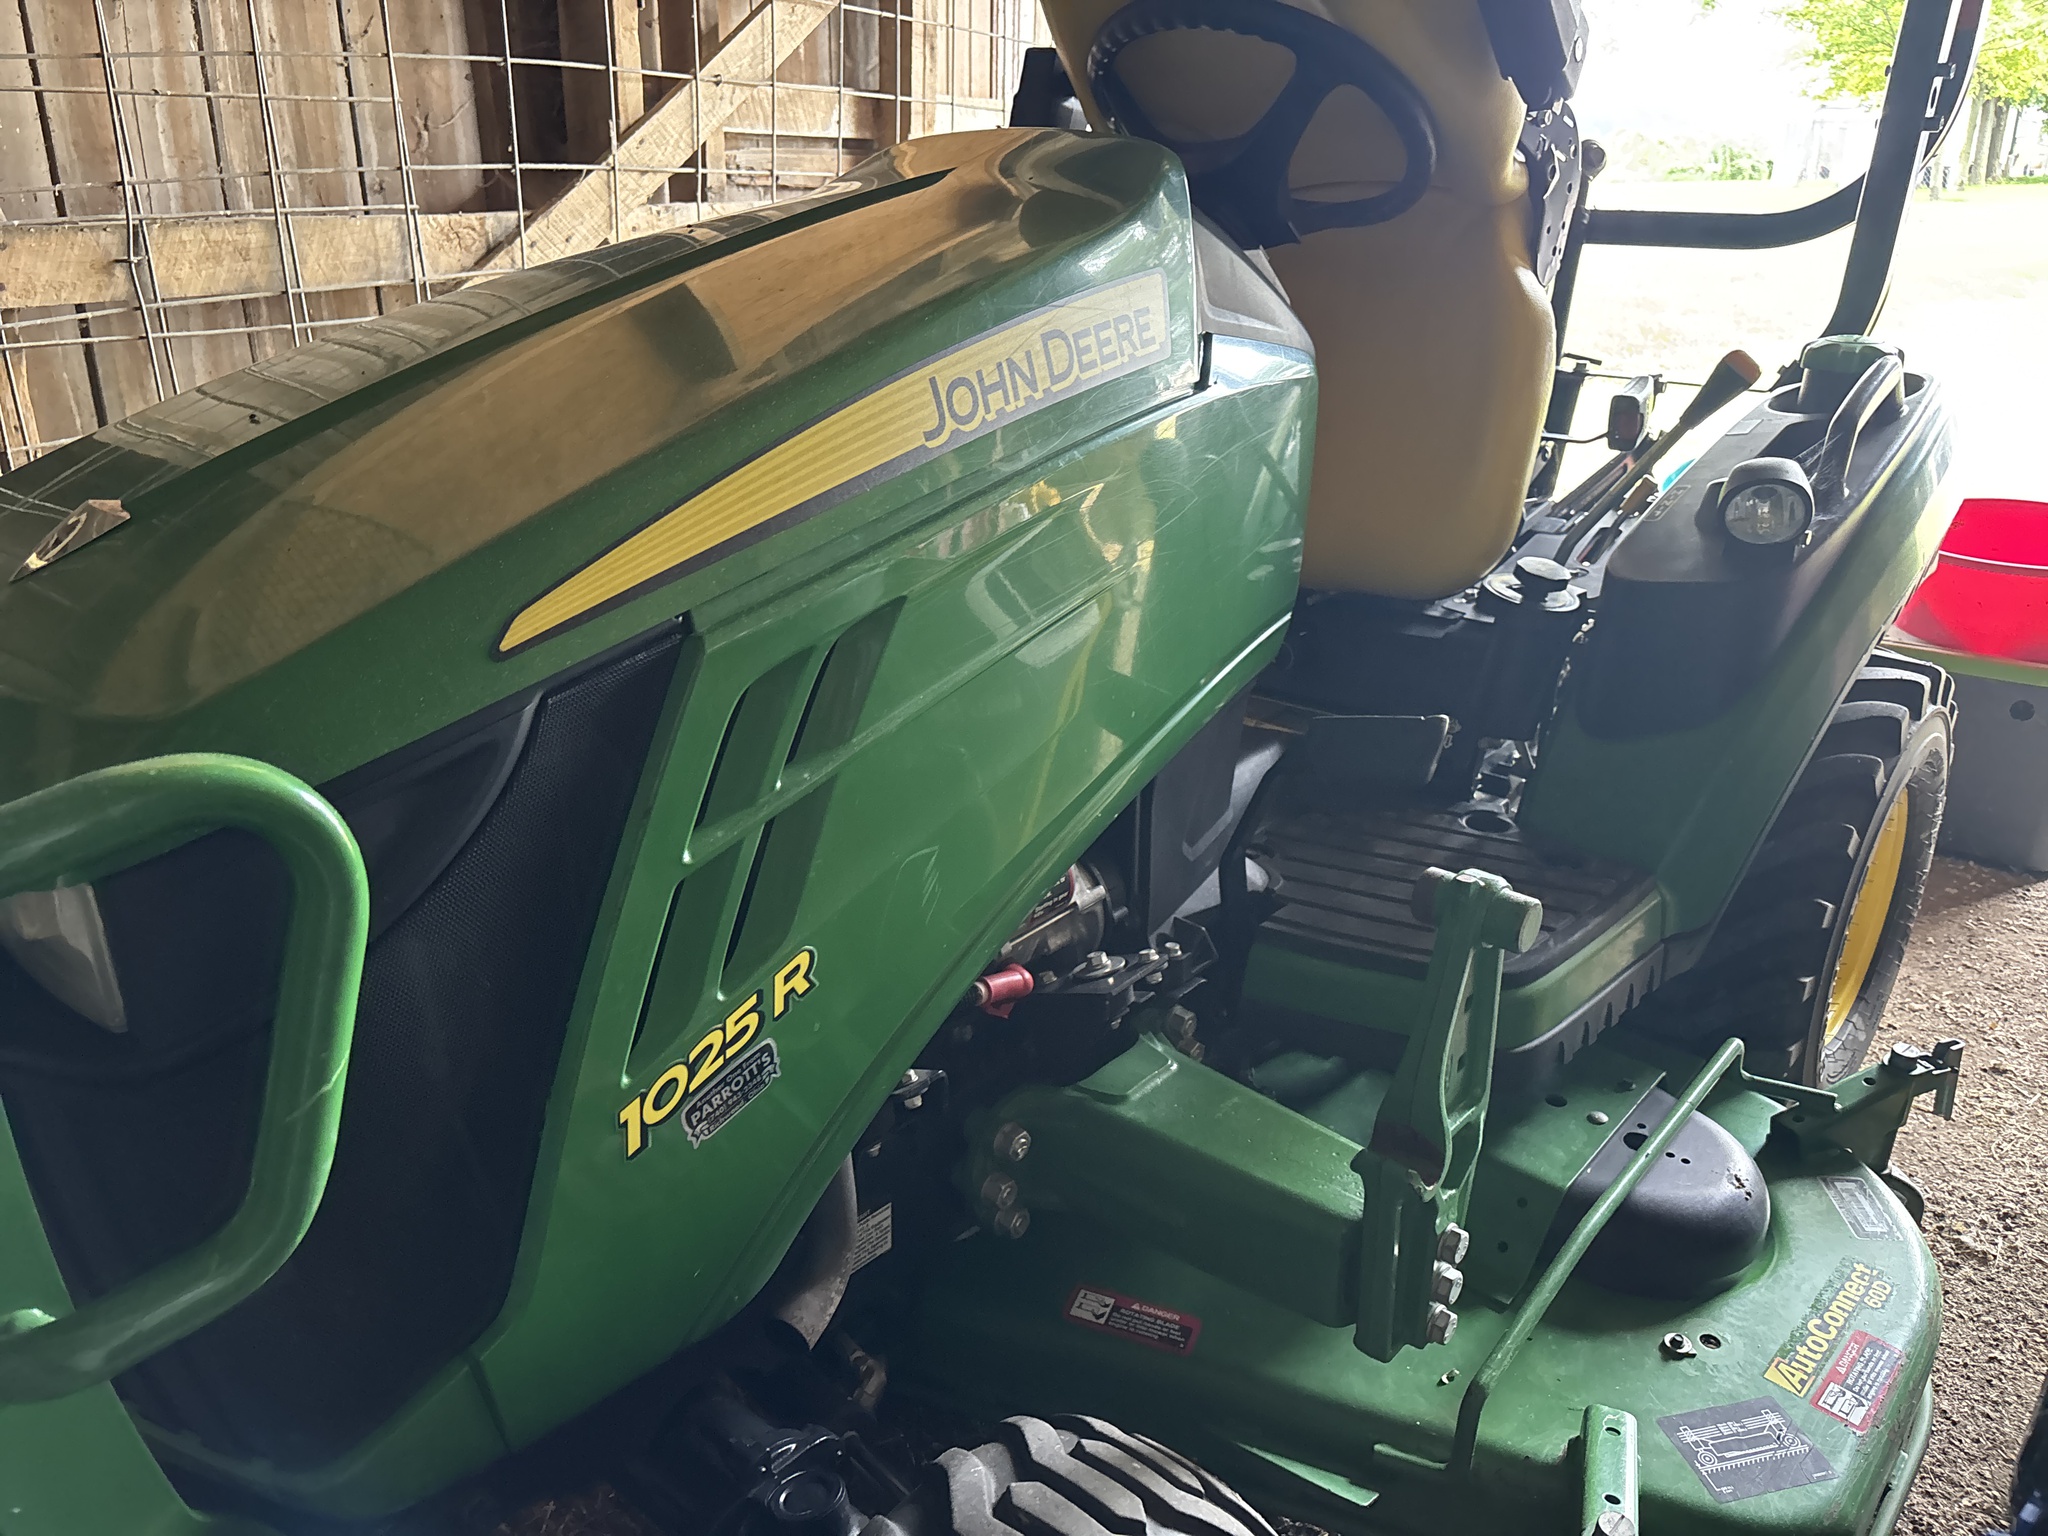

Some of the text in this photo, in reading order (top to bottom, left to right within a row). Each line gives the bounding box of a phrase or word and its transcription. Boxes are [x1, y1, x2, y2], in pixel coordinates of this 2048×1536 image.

[923, 306, 1157, 442] JOHN DEERE
[618, 949, 813, 1159] 1025 R
[726, 1068, 742, 1082] One
[742, 1052, 761, 1069] From
[690, 1052, 771, 1126] PARROTT'S
[747, 1083, 765, 1099] Ohio
[1863, 1280, 1892, 1309] 60D
[1119, 1308, 1180, 1329] ROTATING BLADE
[1140, 1305, 1180, 1321] DANGER
[1777, 1262, 1874, 1391] AutoConnect
[1840, 1342, 1860, 1369] DANGER
[1846, 1359, 1863, 1386] ROTATING
